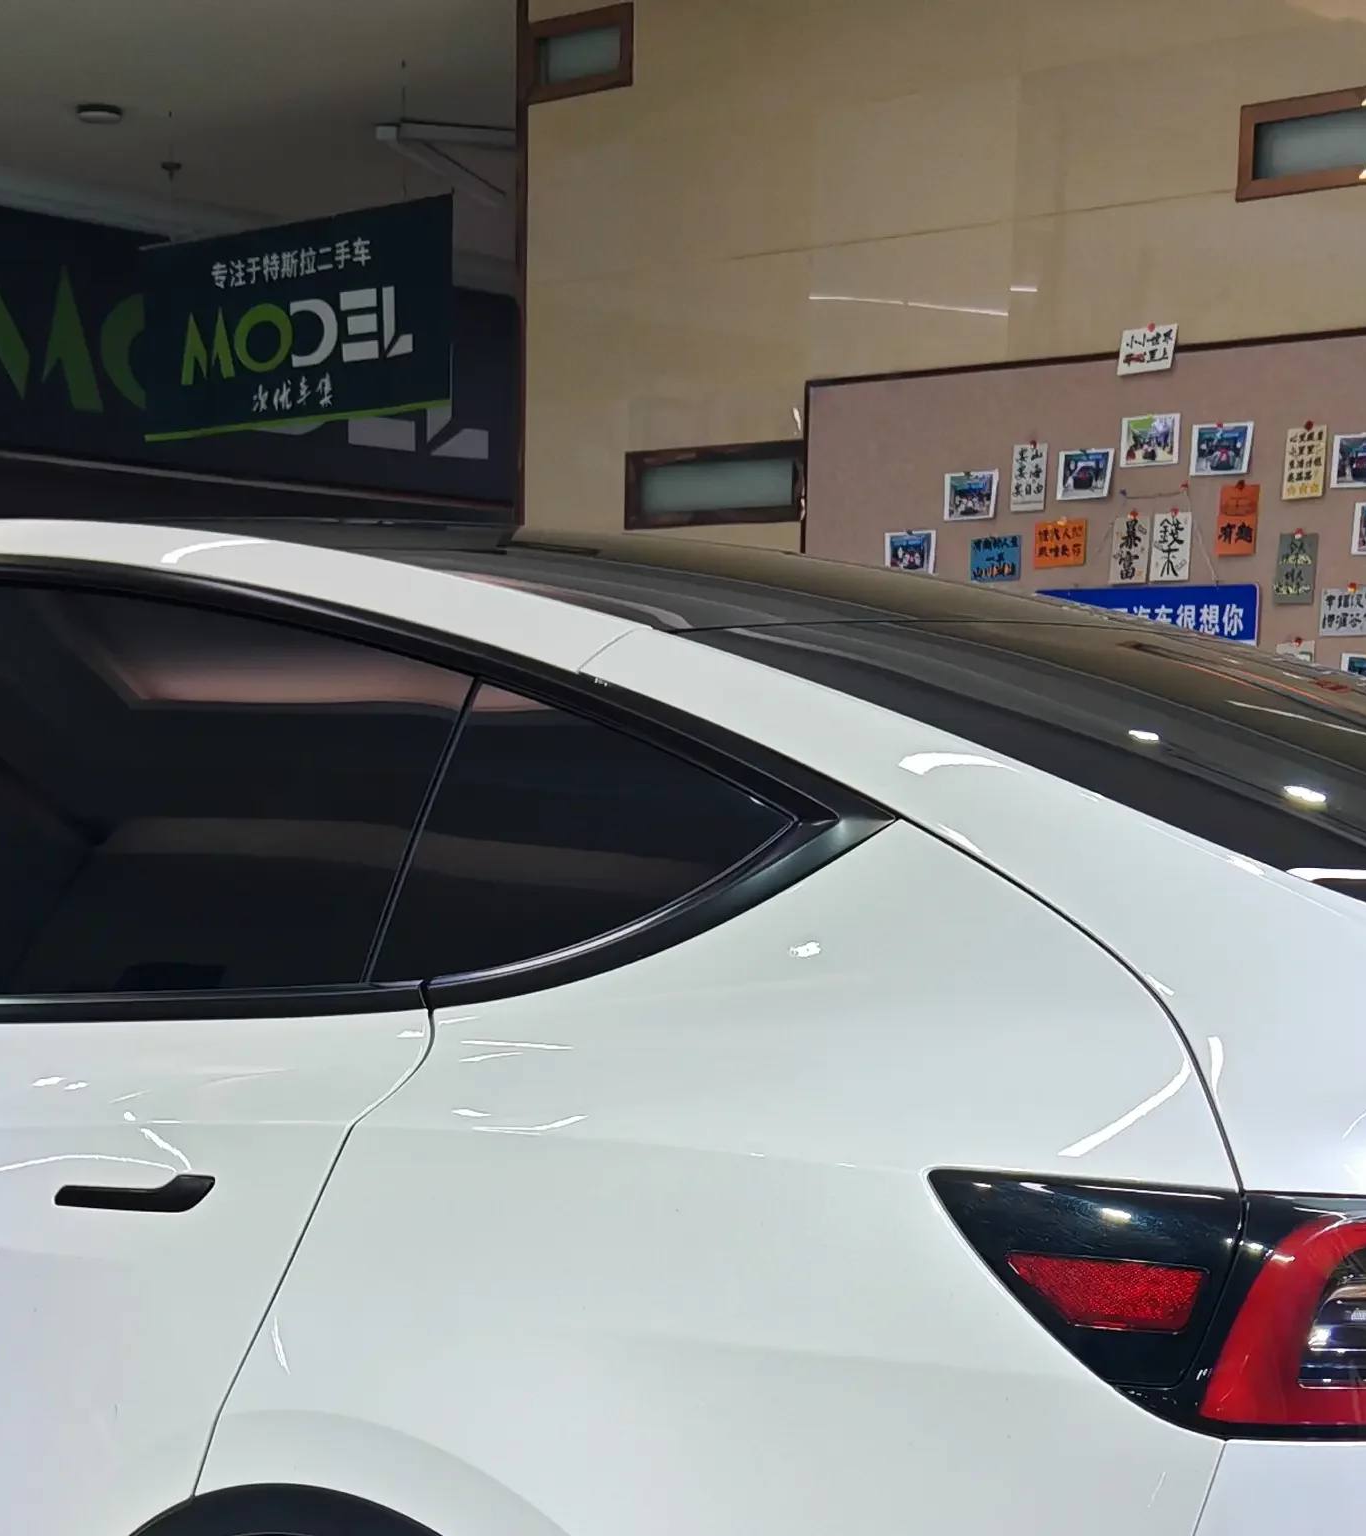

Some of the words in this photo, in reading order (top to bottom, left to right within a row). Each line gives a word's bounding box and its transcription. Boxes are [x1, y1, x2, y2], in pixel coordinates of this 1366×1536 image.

[211, 237, 372, 288] 专注于特斯拉二手车
[181, 286, 413, 385] MODEL
